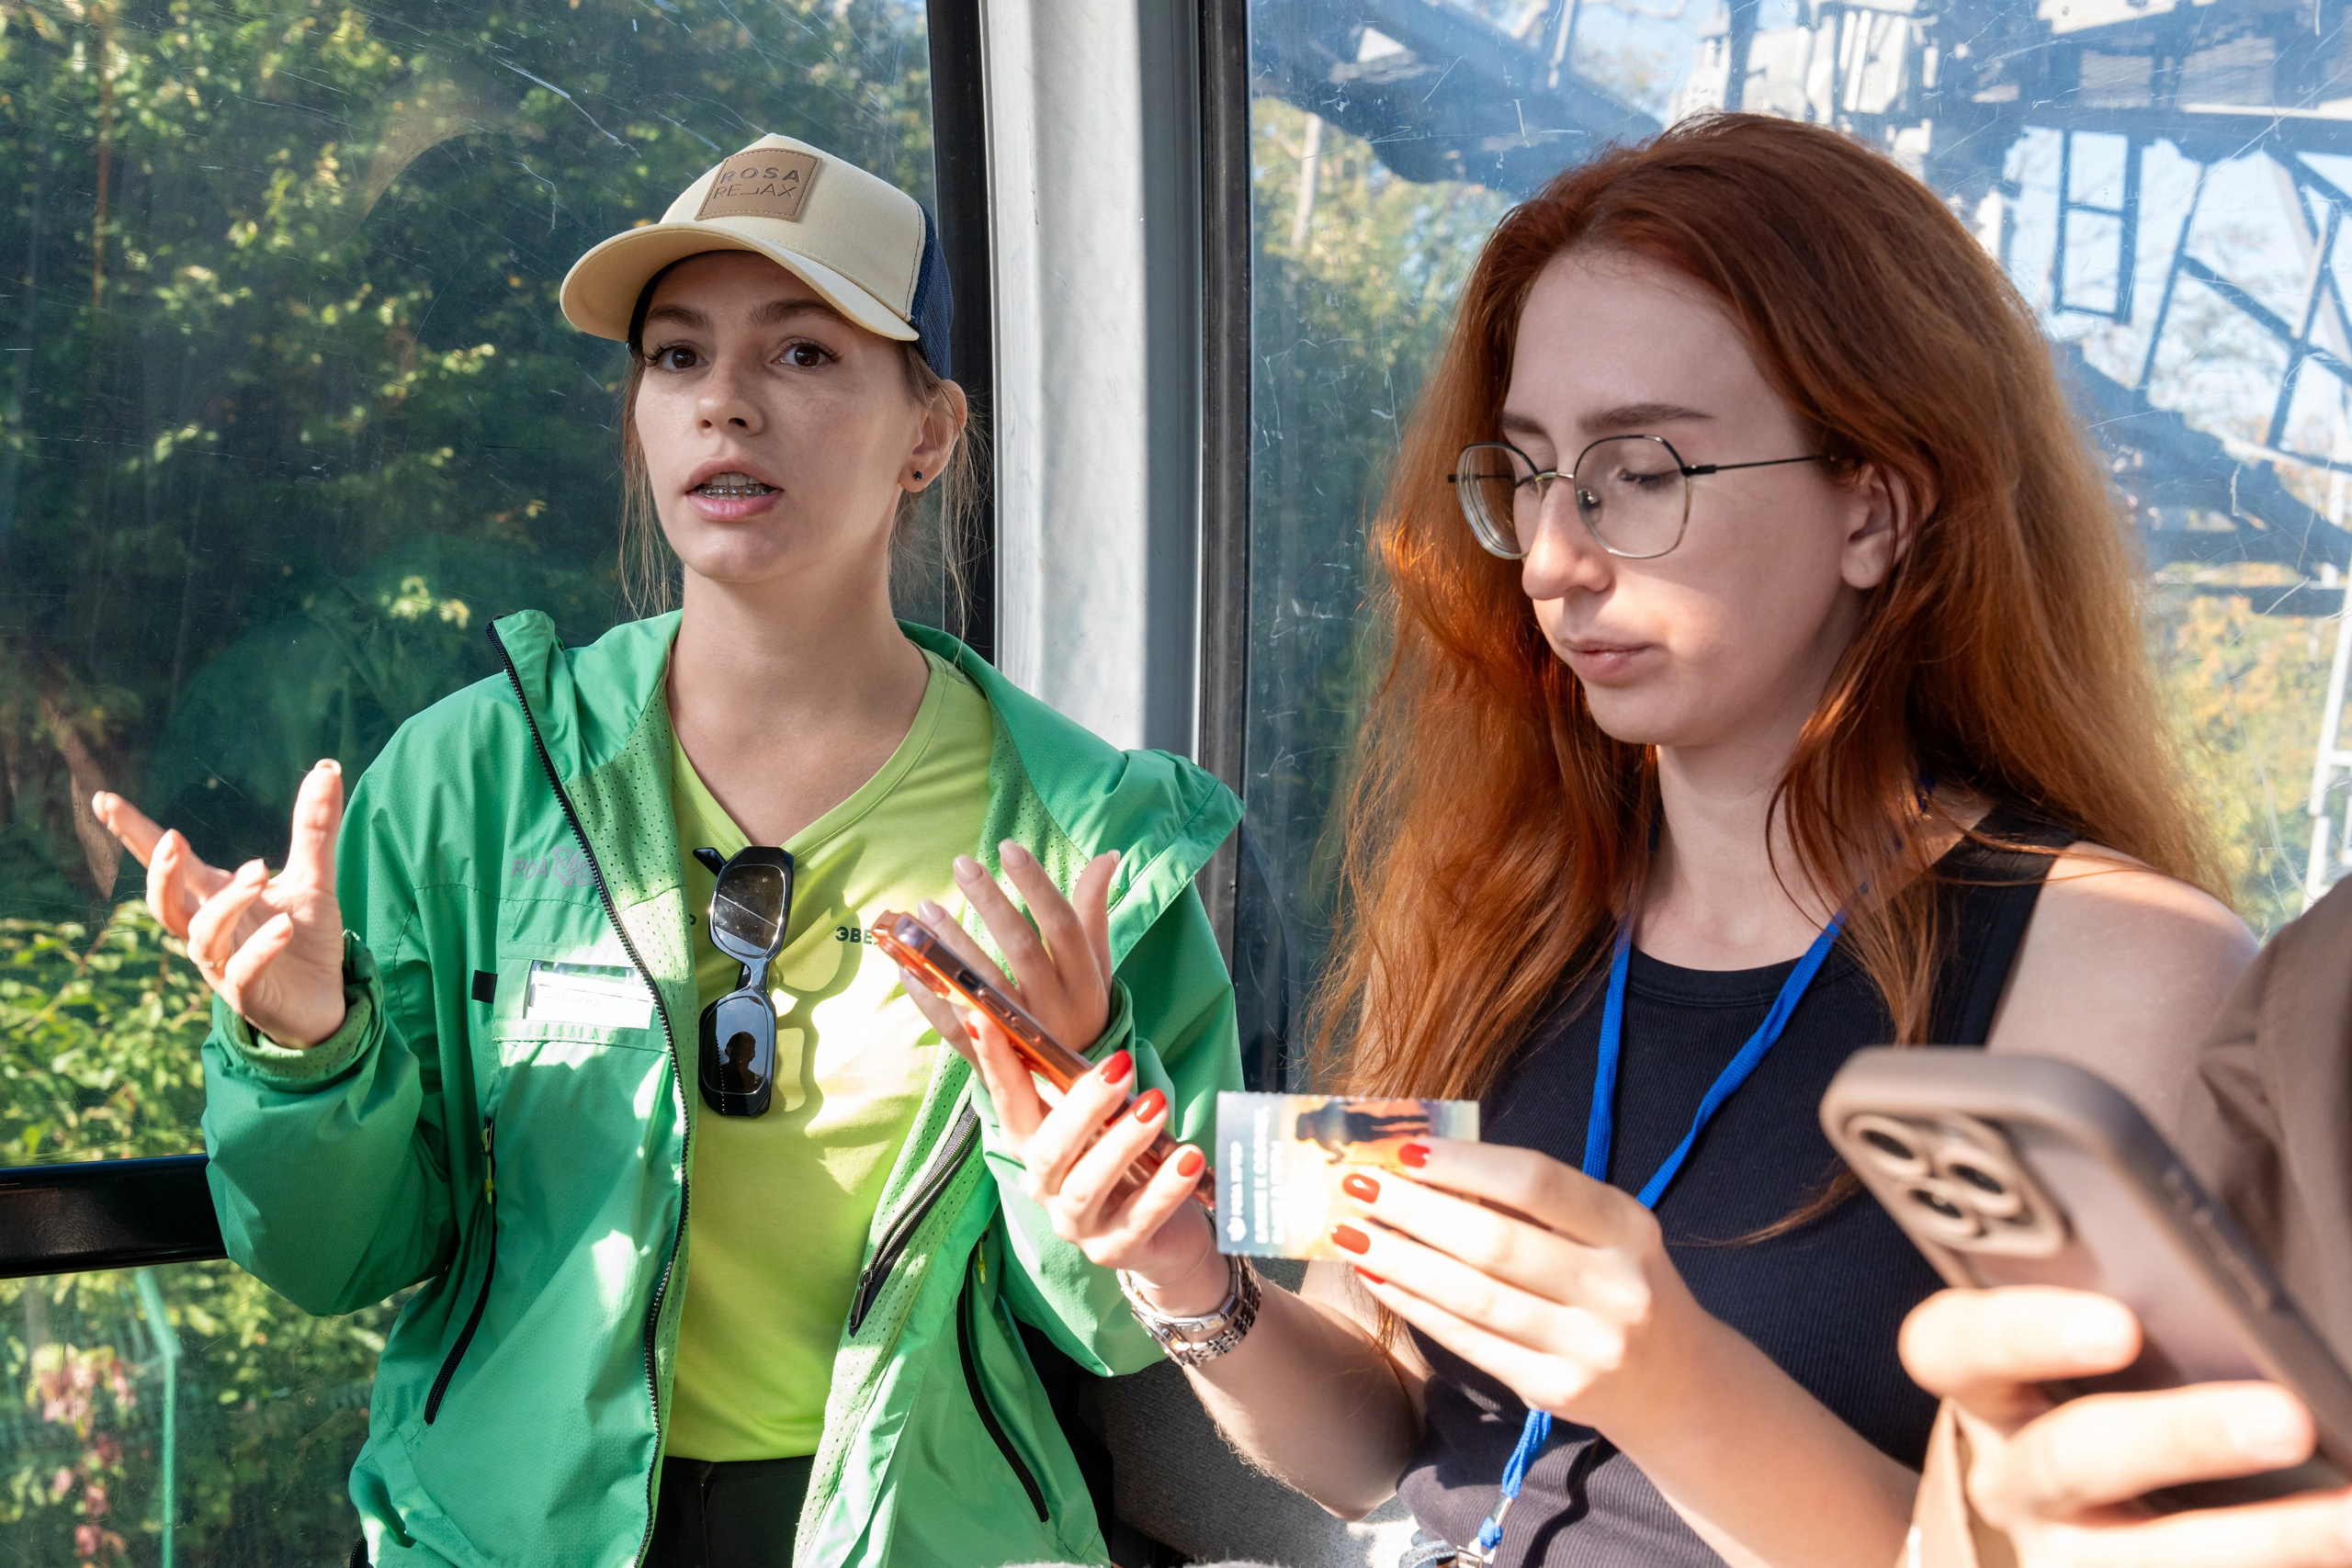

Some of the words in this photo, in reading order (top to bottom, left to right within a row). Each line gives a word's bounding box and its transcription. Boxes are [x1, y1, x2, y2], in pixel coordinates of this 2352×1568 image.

[720, 166, 801, 184] ROSA
[834, 926, 877, 945] ЭВЕ
[545, 991, 601, 1008] Эвелина
